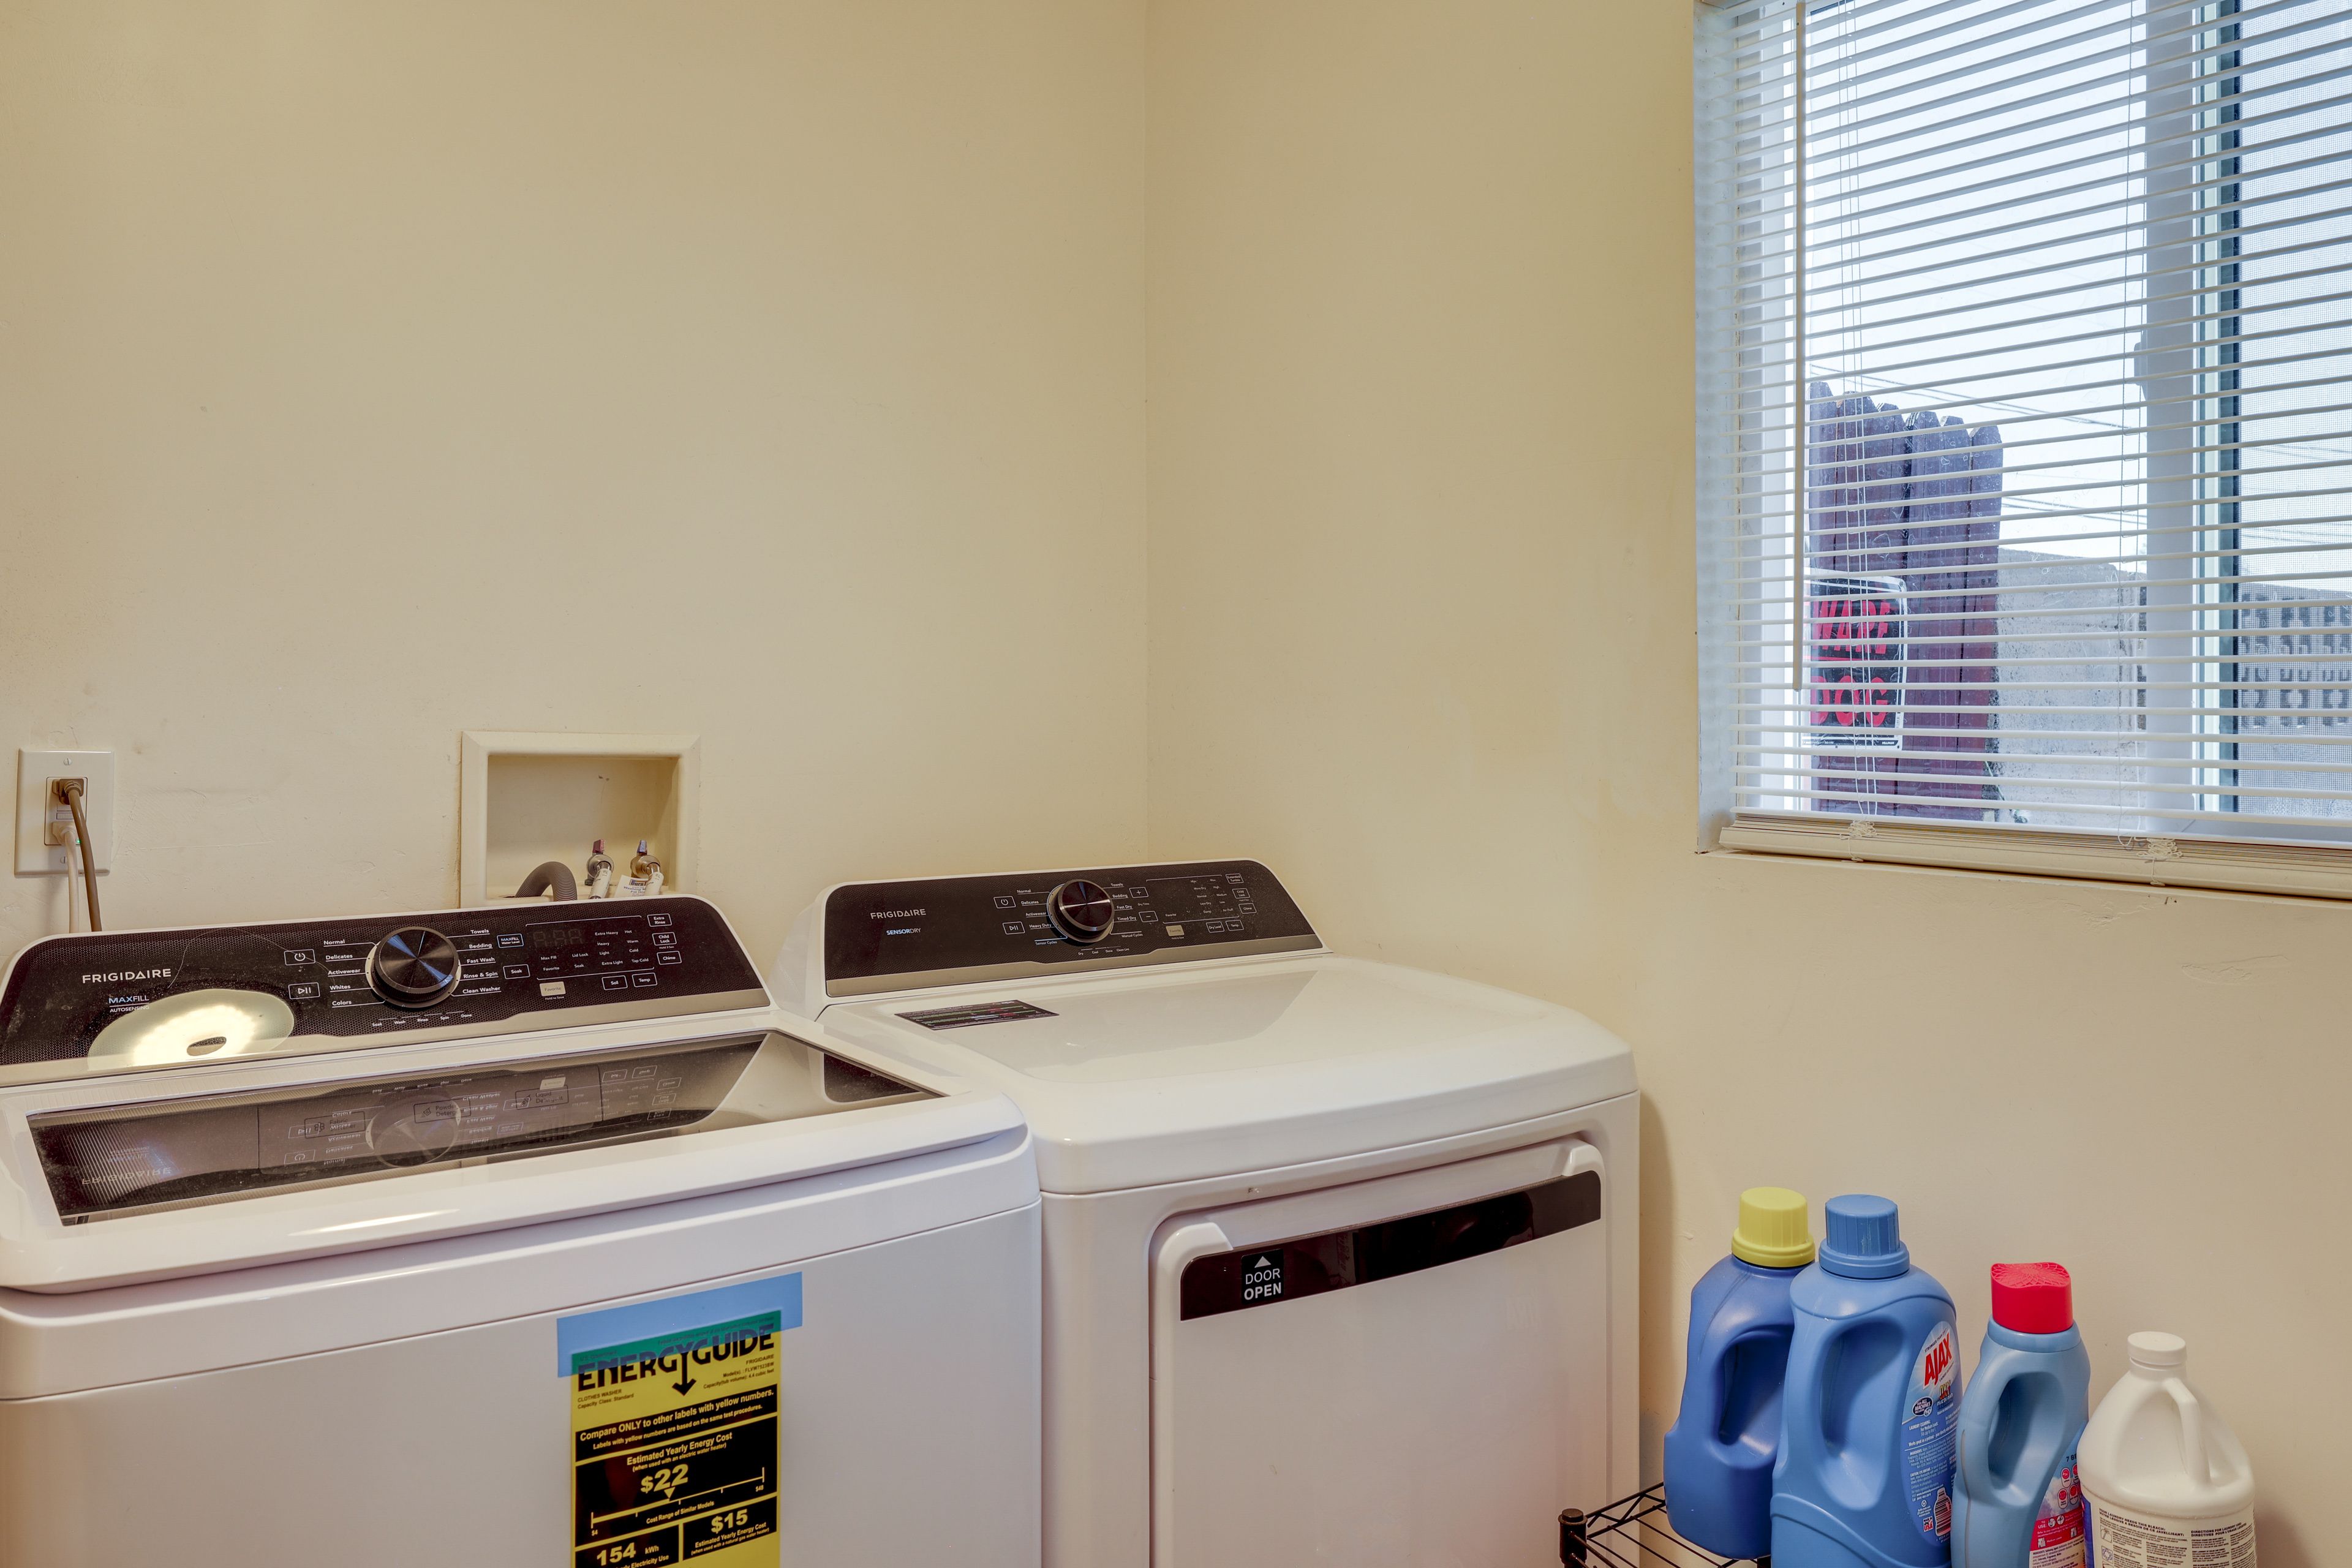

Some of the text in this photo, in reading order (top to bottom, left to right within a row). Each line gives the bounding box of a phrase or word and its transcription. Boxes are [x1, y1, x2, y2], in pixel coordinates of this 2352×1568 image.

[1804, 600, 1891, 654] WARE
[870, 908, 926, 919] FRIGIDAIRE
[82, 968, 172, 984] FRIGIDAIRE
[108, 995, 149, 1004] MAXFILL
[1245, 1268, 1281, 1284] DOOR
[1244, 1282, 1282, 1301] OPEN
[1924, 1340, 1937, 1353] STRONGER
[578, 1323, 774, 1393] ENERGYGUIDE
[745, 1354, 774, 1365] FRIGIDAIRE
[1924, 1332, 1952, 1386] AJAX
[578, 1389, 622, 1403] CLOTHES WASHER
[578, 1401, 597, 1409] Capacity
[614, 1393, 635, 1402] Standard
[580, 1389, 774, 1441] Compare ONLY to other labels with yellow numbers.
[593, 1441, 611, 1450] Labels
[625, 1434, 643, 1444] yellow
[643, 1429, 667, 1439] numbers
[676, 1422, 692, 1431] based
[734, 1404, 763, 1417] procedures.
[627, 1432, 733, 1466] Estimated Yearly Energy Cost
[633, 1463, 648, 1472] (when
[679, 1451, 696, 1460] electric
[710, 1442, 727, 1452] heater)
[641, 1464, 688, 1494] $22
[646, 1515, 658, 1525] Cost
[658, 1510, 674, 1521] Range
[680, 1505, 697, 1515] Similar
[698, 1501, 714, 1510] Models
[710, 1509, 748, 1534] $15
[2108, 1512, 2124, 1521] LAUNDRY
[695, 1521, 766, 1548] Estimated Yearly Energy Cost
[1924, 1523, 1933, 1531] USA
[597, 1542, 636, 1566] 154
[645, 1545, 659, 1555] kWh
[691, 1547, 703, 1556] (when
[725, 1537, 738, 1546] natural
[631, 1556, 657, 1568] Electricity
